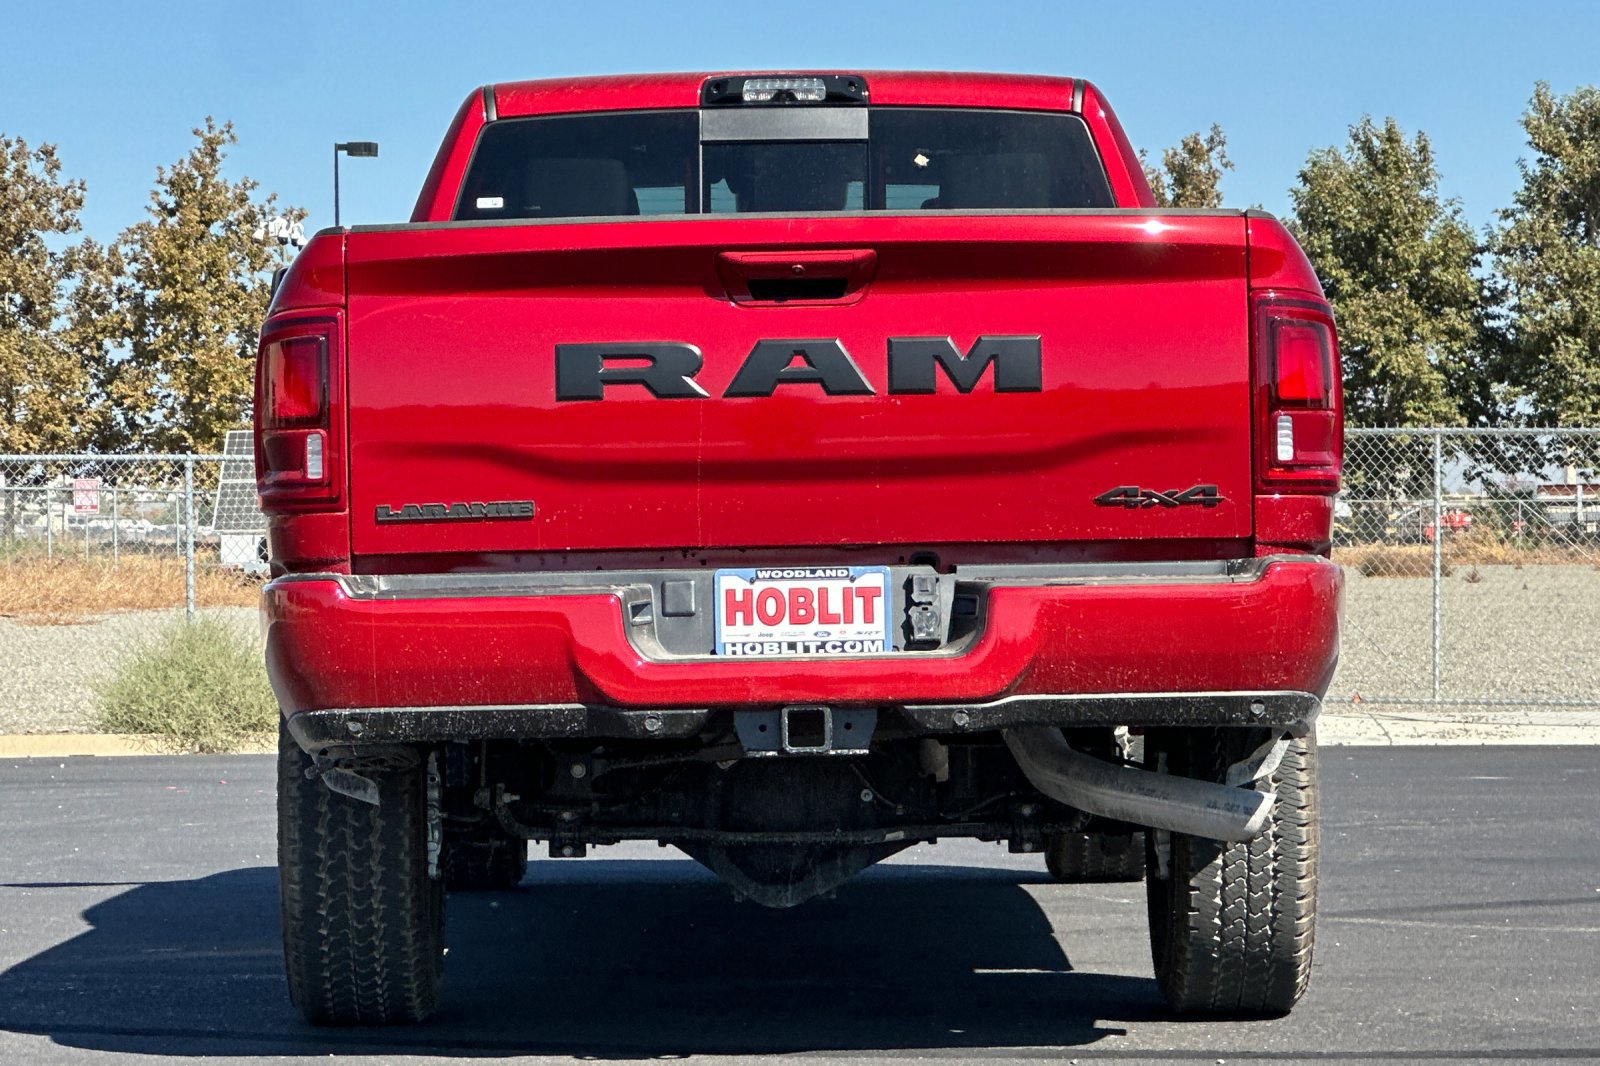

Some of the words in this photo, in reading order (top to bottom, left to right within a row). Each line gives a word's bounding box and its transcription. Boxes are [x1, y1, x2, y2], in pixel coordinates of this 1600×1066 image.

[555, 335, 1043, 401] RAM
[1093, 485, 1226, 509] 4x4
[375, 501, 535, 524] LARAMIE
[756, 569, 849, 579] WOODLAND
[725, 586, 882, 627] HOBLIT
[757, 631, 774, 639] Jeep
[725, 641, 884, 655] HOBLIT.COM
